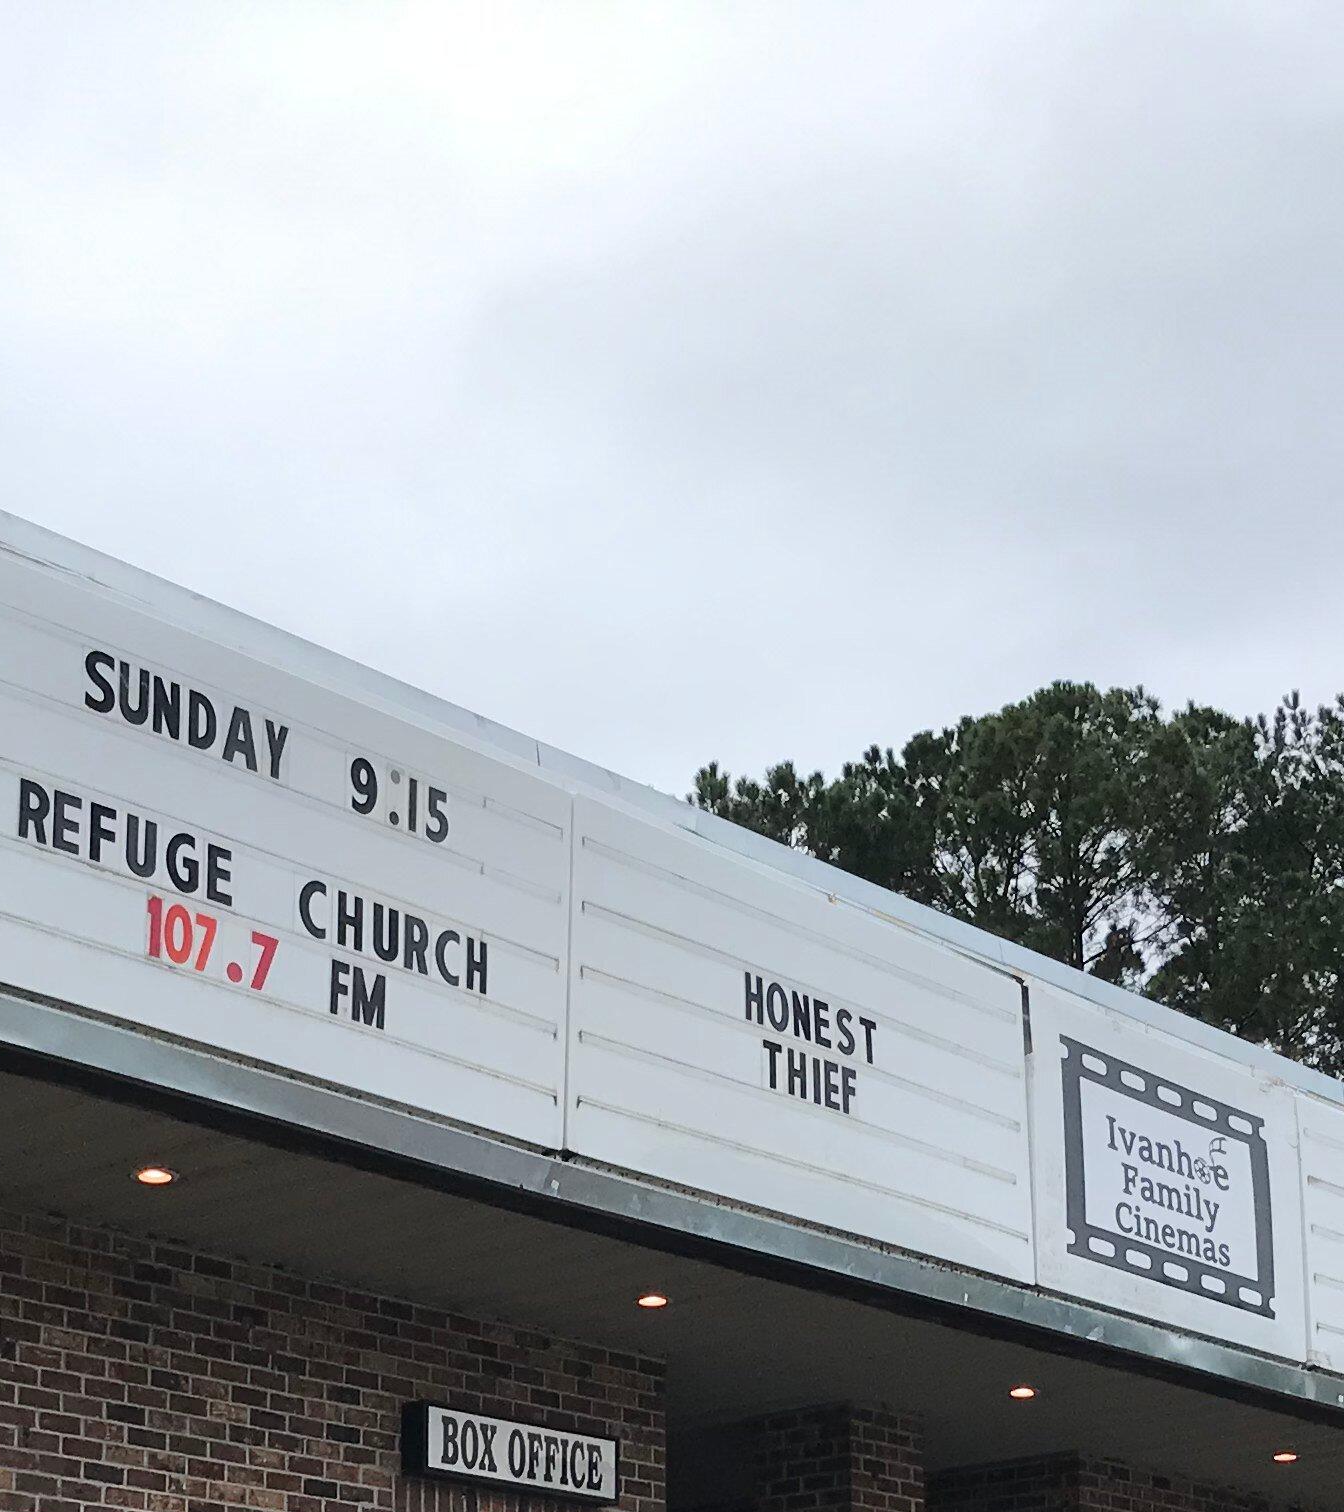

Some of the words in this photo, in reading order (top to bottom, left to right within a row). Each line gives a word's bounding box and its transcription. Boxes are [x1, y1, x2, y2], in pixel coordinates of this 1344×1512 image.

[84, 650, 289, 780] SUNDAY
[350, 757, 449, 844] 9:15
[18, 777, 233, 907] REFUGE
[298, 880, 488, 995] CHURCH
[147, 894, 280, 991] 107.7
[329, 958, 386, 1031] FM
[744, 971, 877, 1065] HONEST
[762, 1038, 857, 1115] THIEF
[1106, 1115, 1230, 1191] Ivanhoe
[1115, 1201, 1231, 1267] Cinemas
[1121, 1162, 1220, 1233] Family
[441, 1415, 498, 1472] BOX
[508, 1428, 603, 1491] OFFICE
